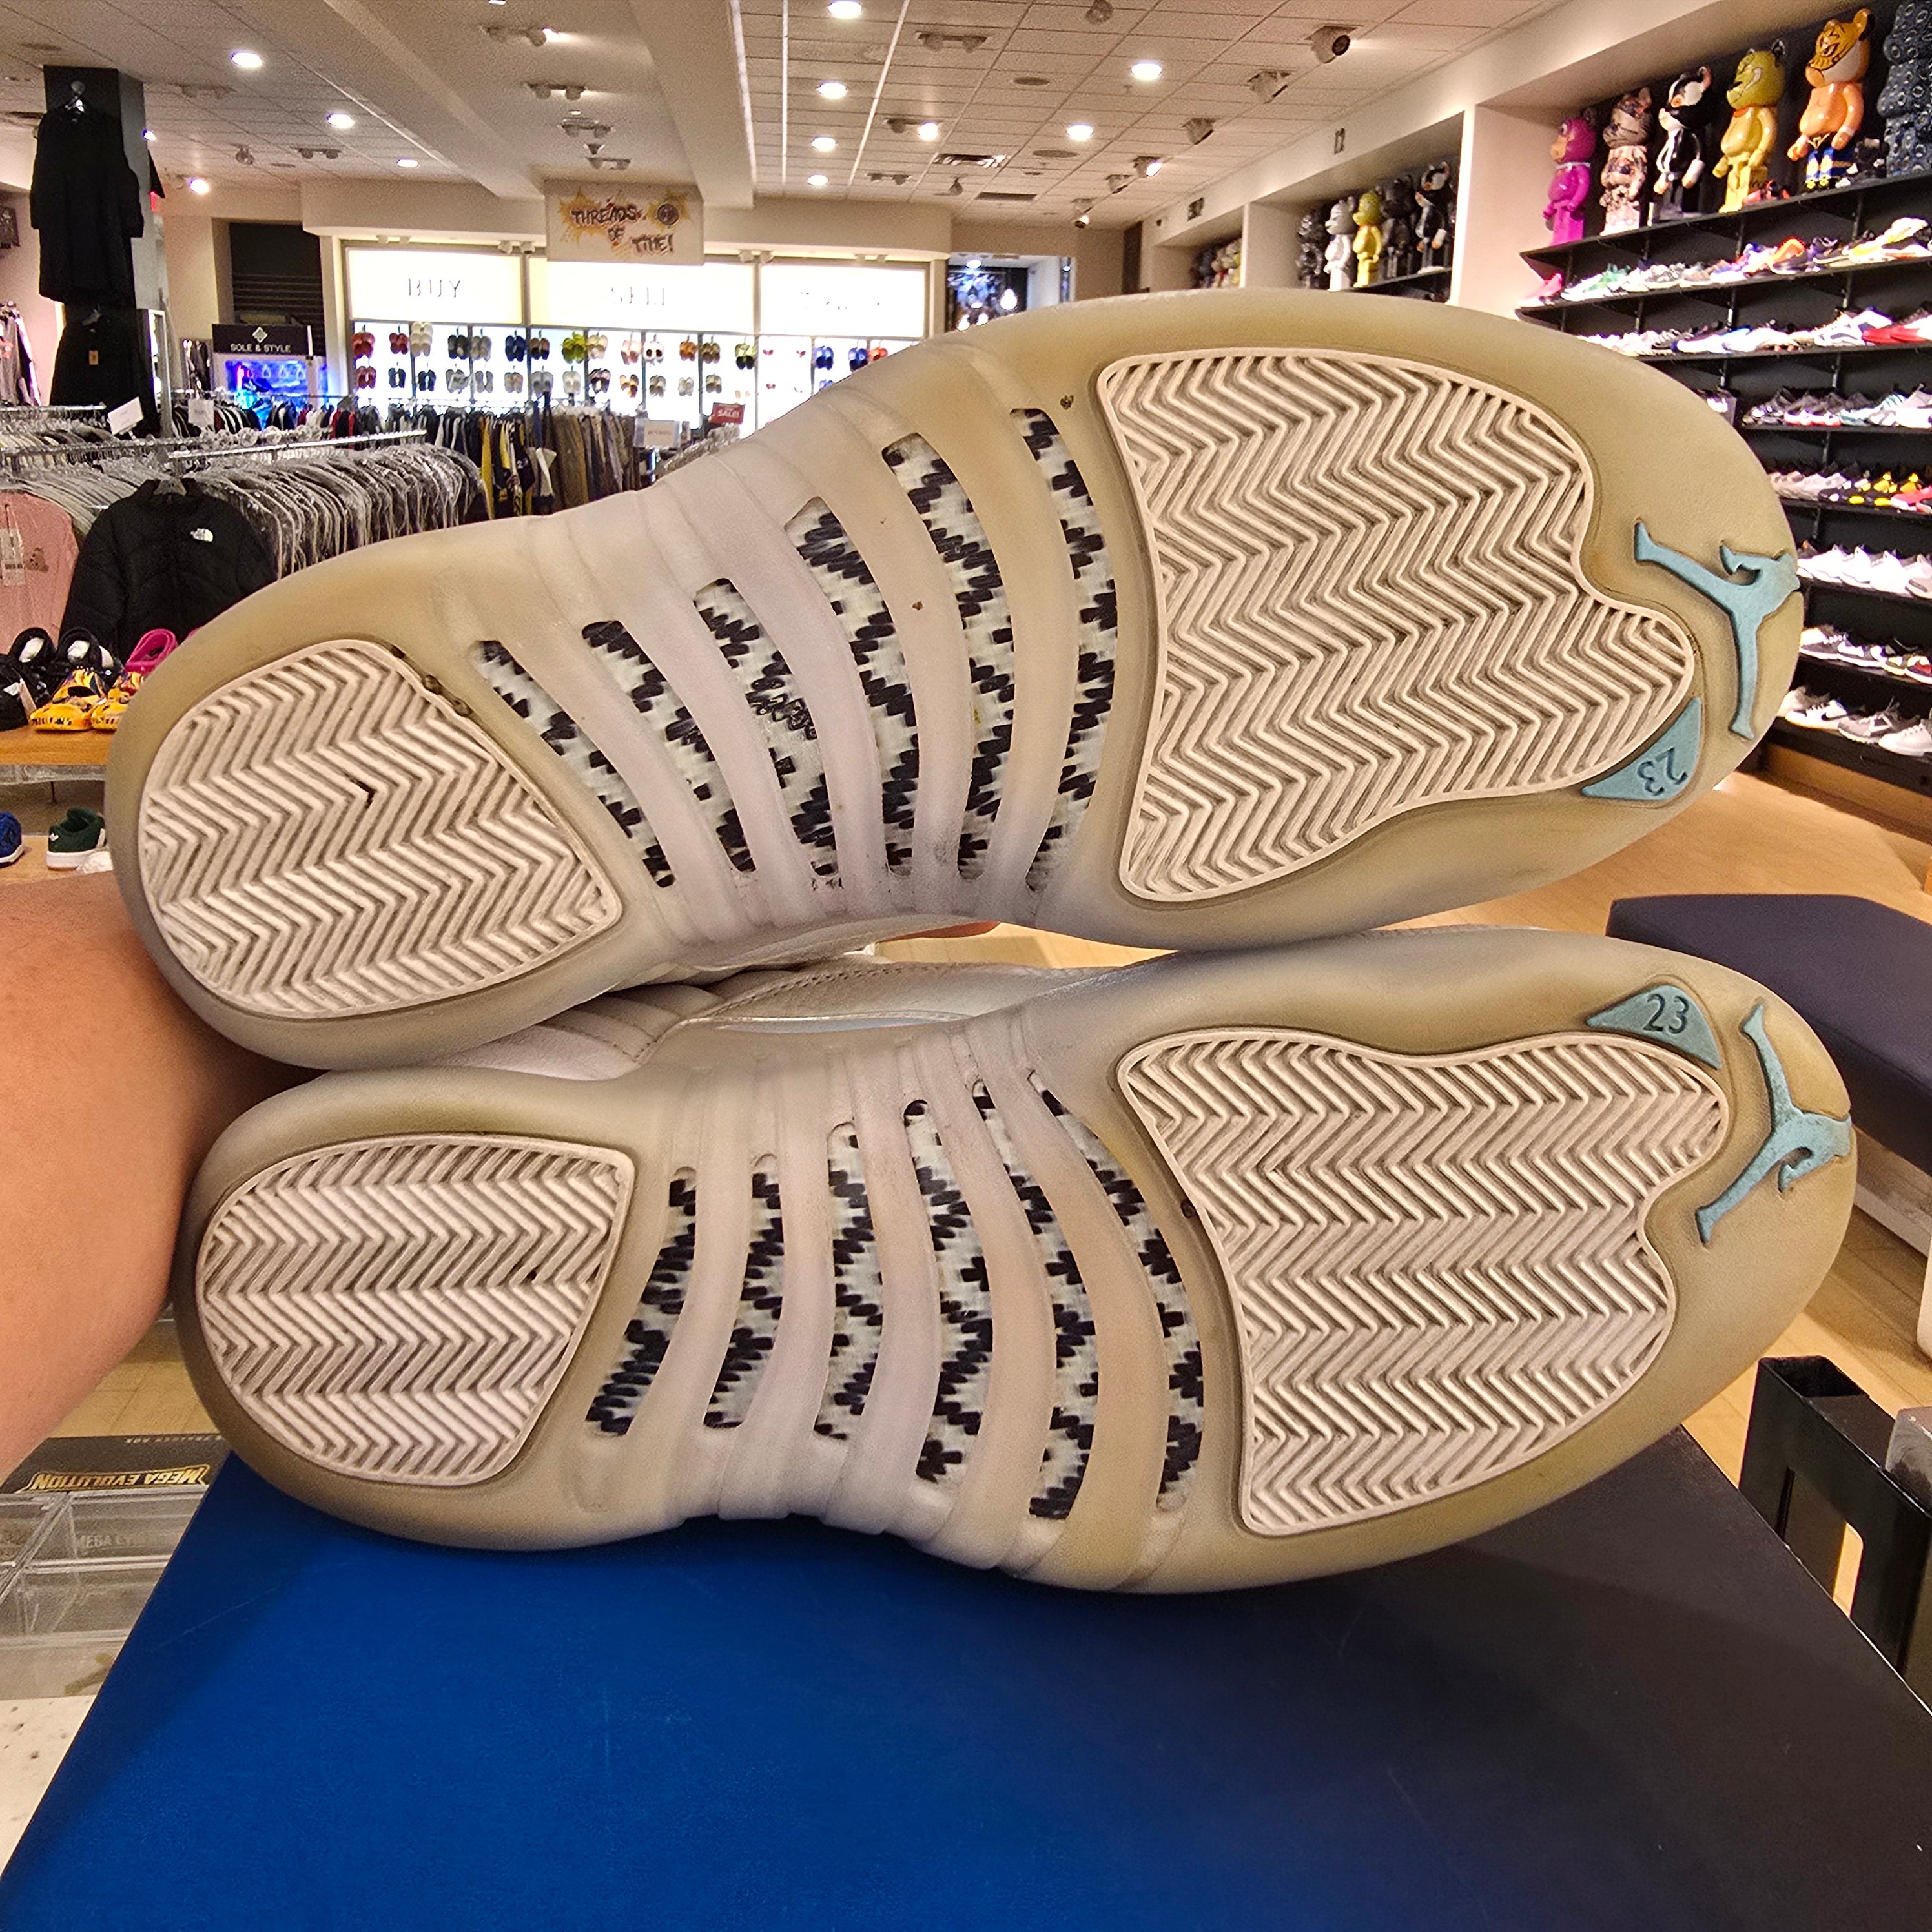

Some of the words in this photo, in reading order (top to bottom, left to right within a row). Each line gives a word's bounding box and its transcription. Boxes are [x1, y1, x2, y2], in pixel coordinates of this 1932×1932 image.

[407, 278, 461, 298] BUY
[263, 344, 291, 353] STYLE
[1636, 746, 1689, 796] 23
[1642, 994, 1689, 1034] 23
[31, 1473, 140, 1490] EVOLUTION
[143, 1466, 205, 1485] MEGA
